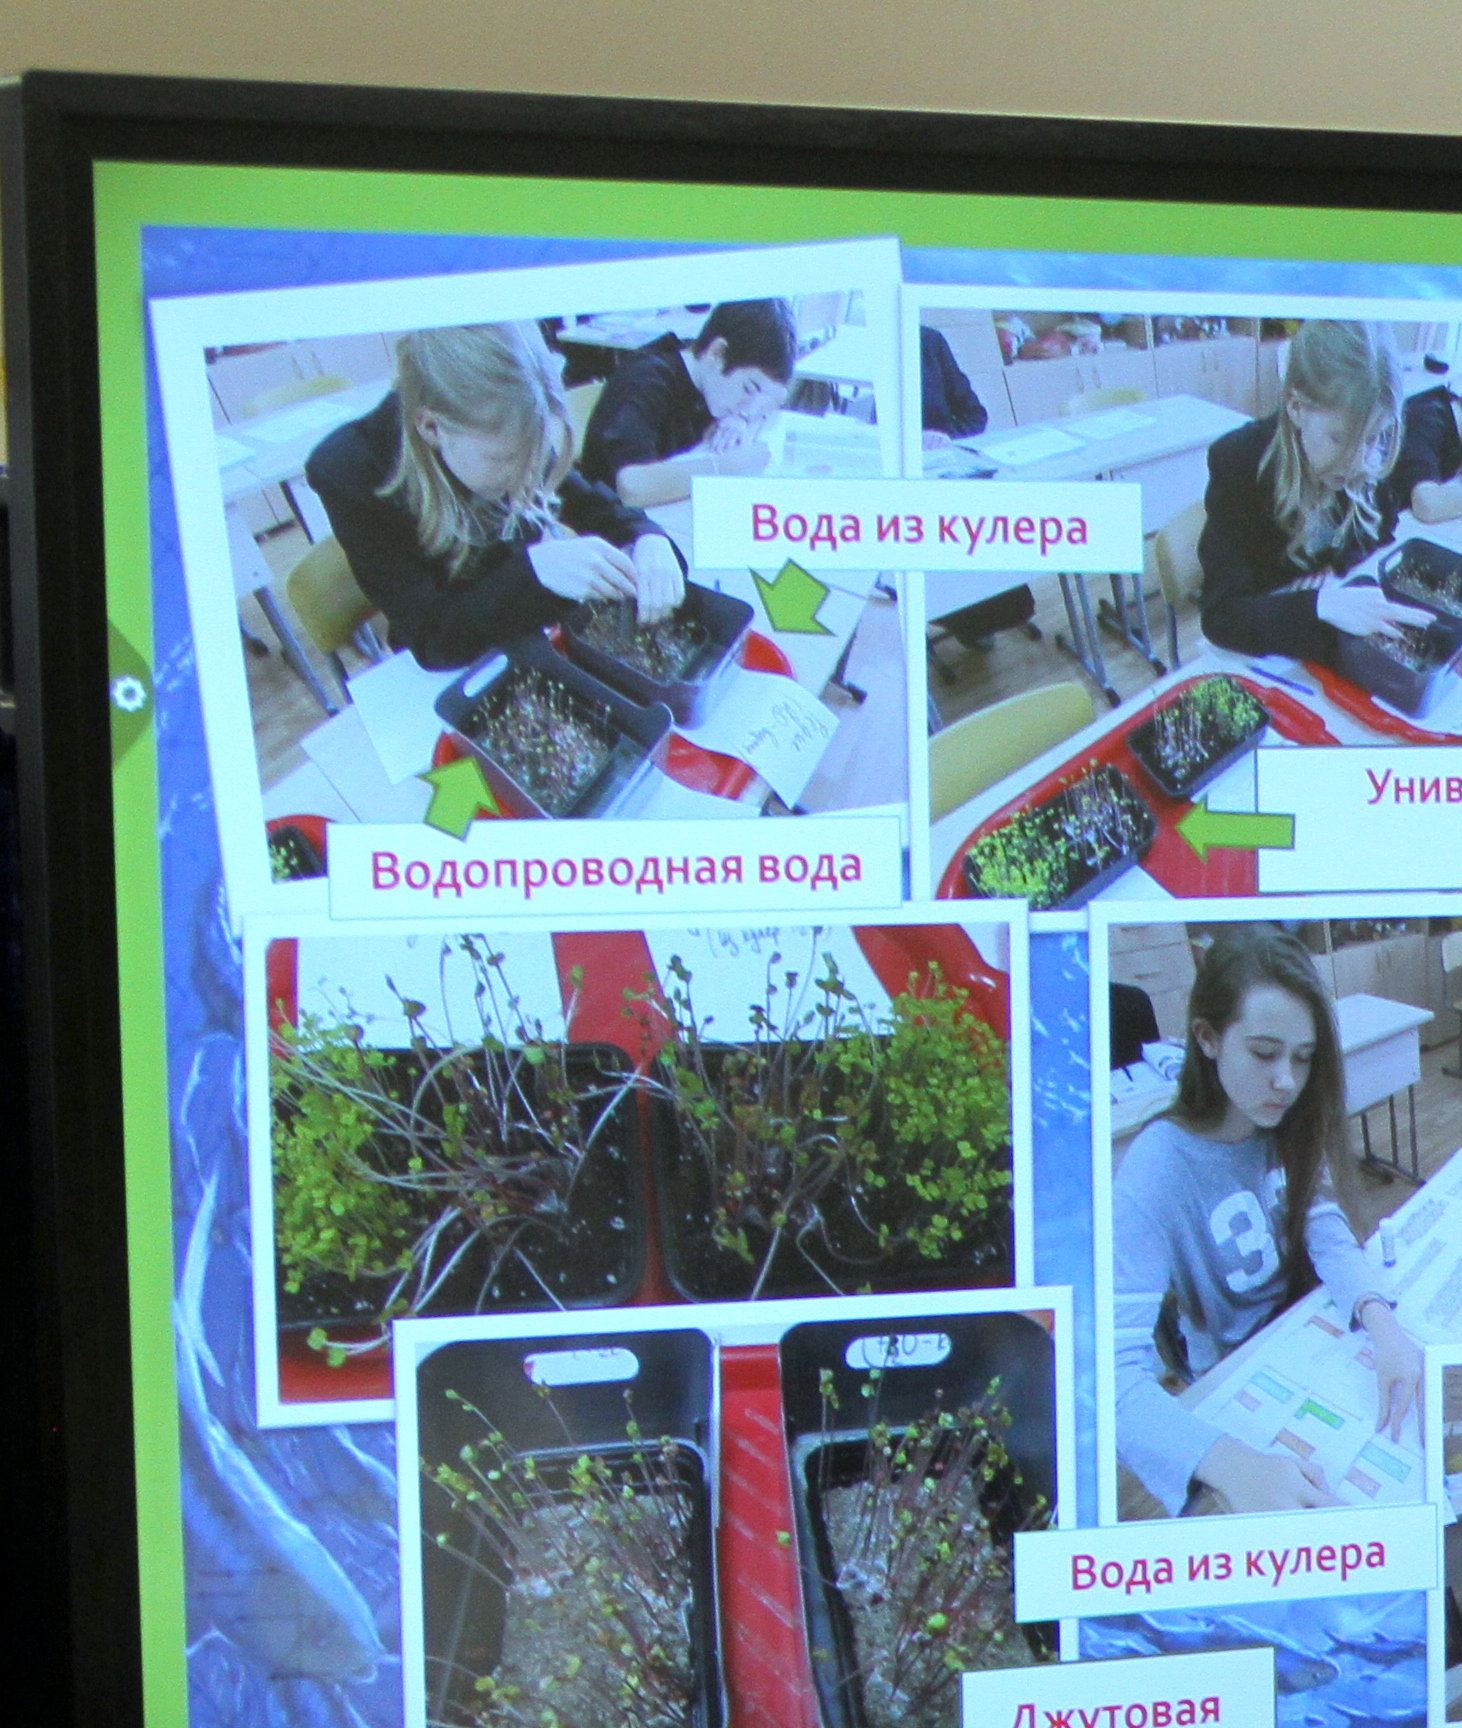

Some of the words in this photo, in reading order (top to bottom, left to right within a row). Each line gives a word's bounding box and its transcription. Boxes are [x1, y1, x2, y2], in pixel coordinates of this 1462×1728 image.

[753, 504, 860, 550] Вода
[877, 515, 923, 543] из
[939, 516, 1087, 555] кулера
[373, 852, 742, 899] Водопроводная
[759, 854, 861, 890] вода
[1073, 1555, 1172, 1594] Вода
[1189, 1553, 1232, 1581] из
[1247, 1542, 1384, 1586] кулера
